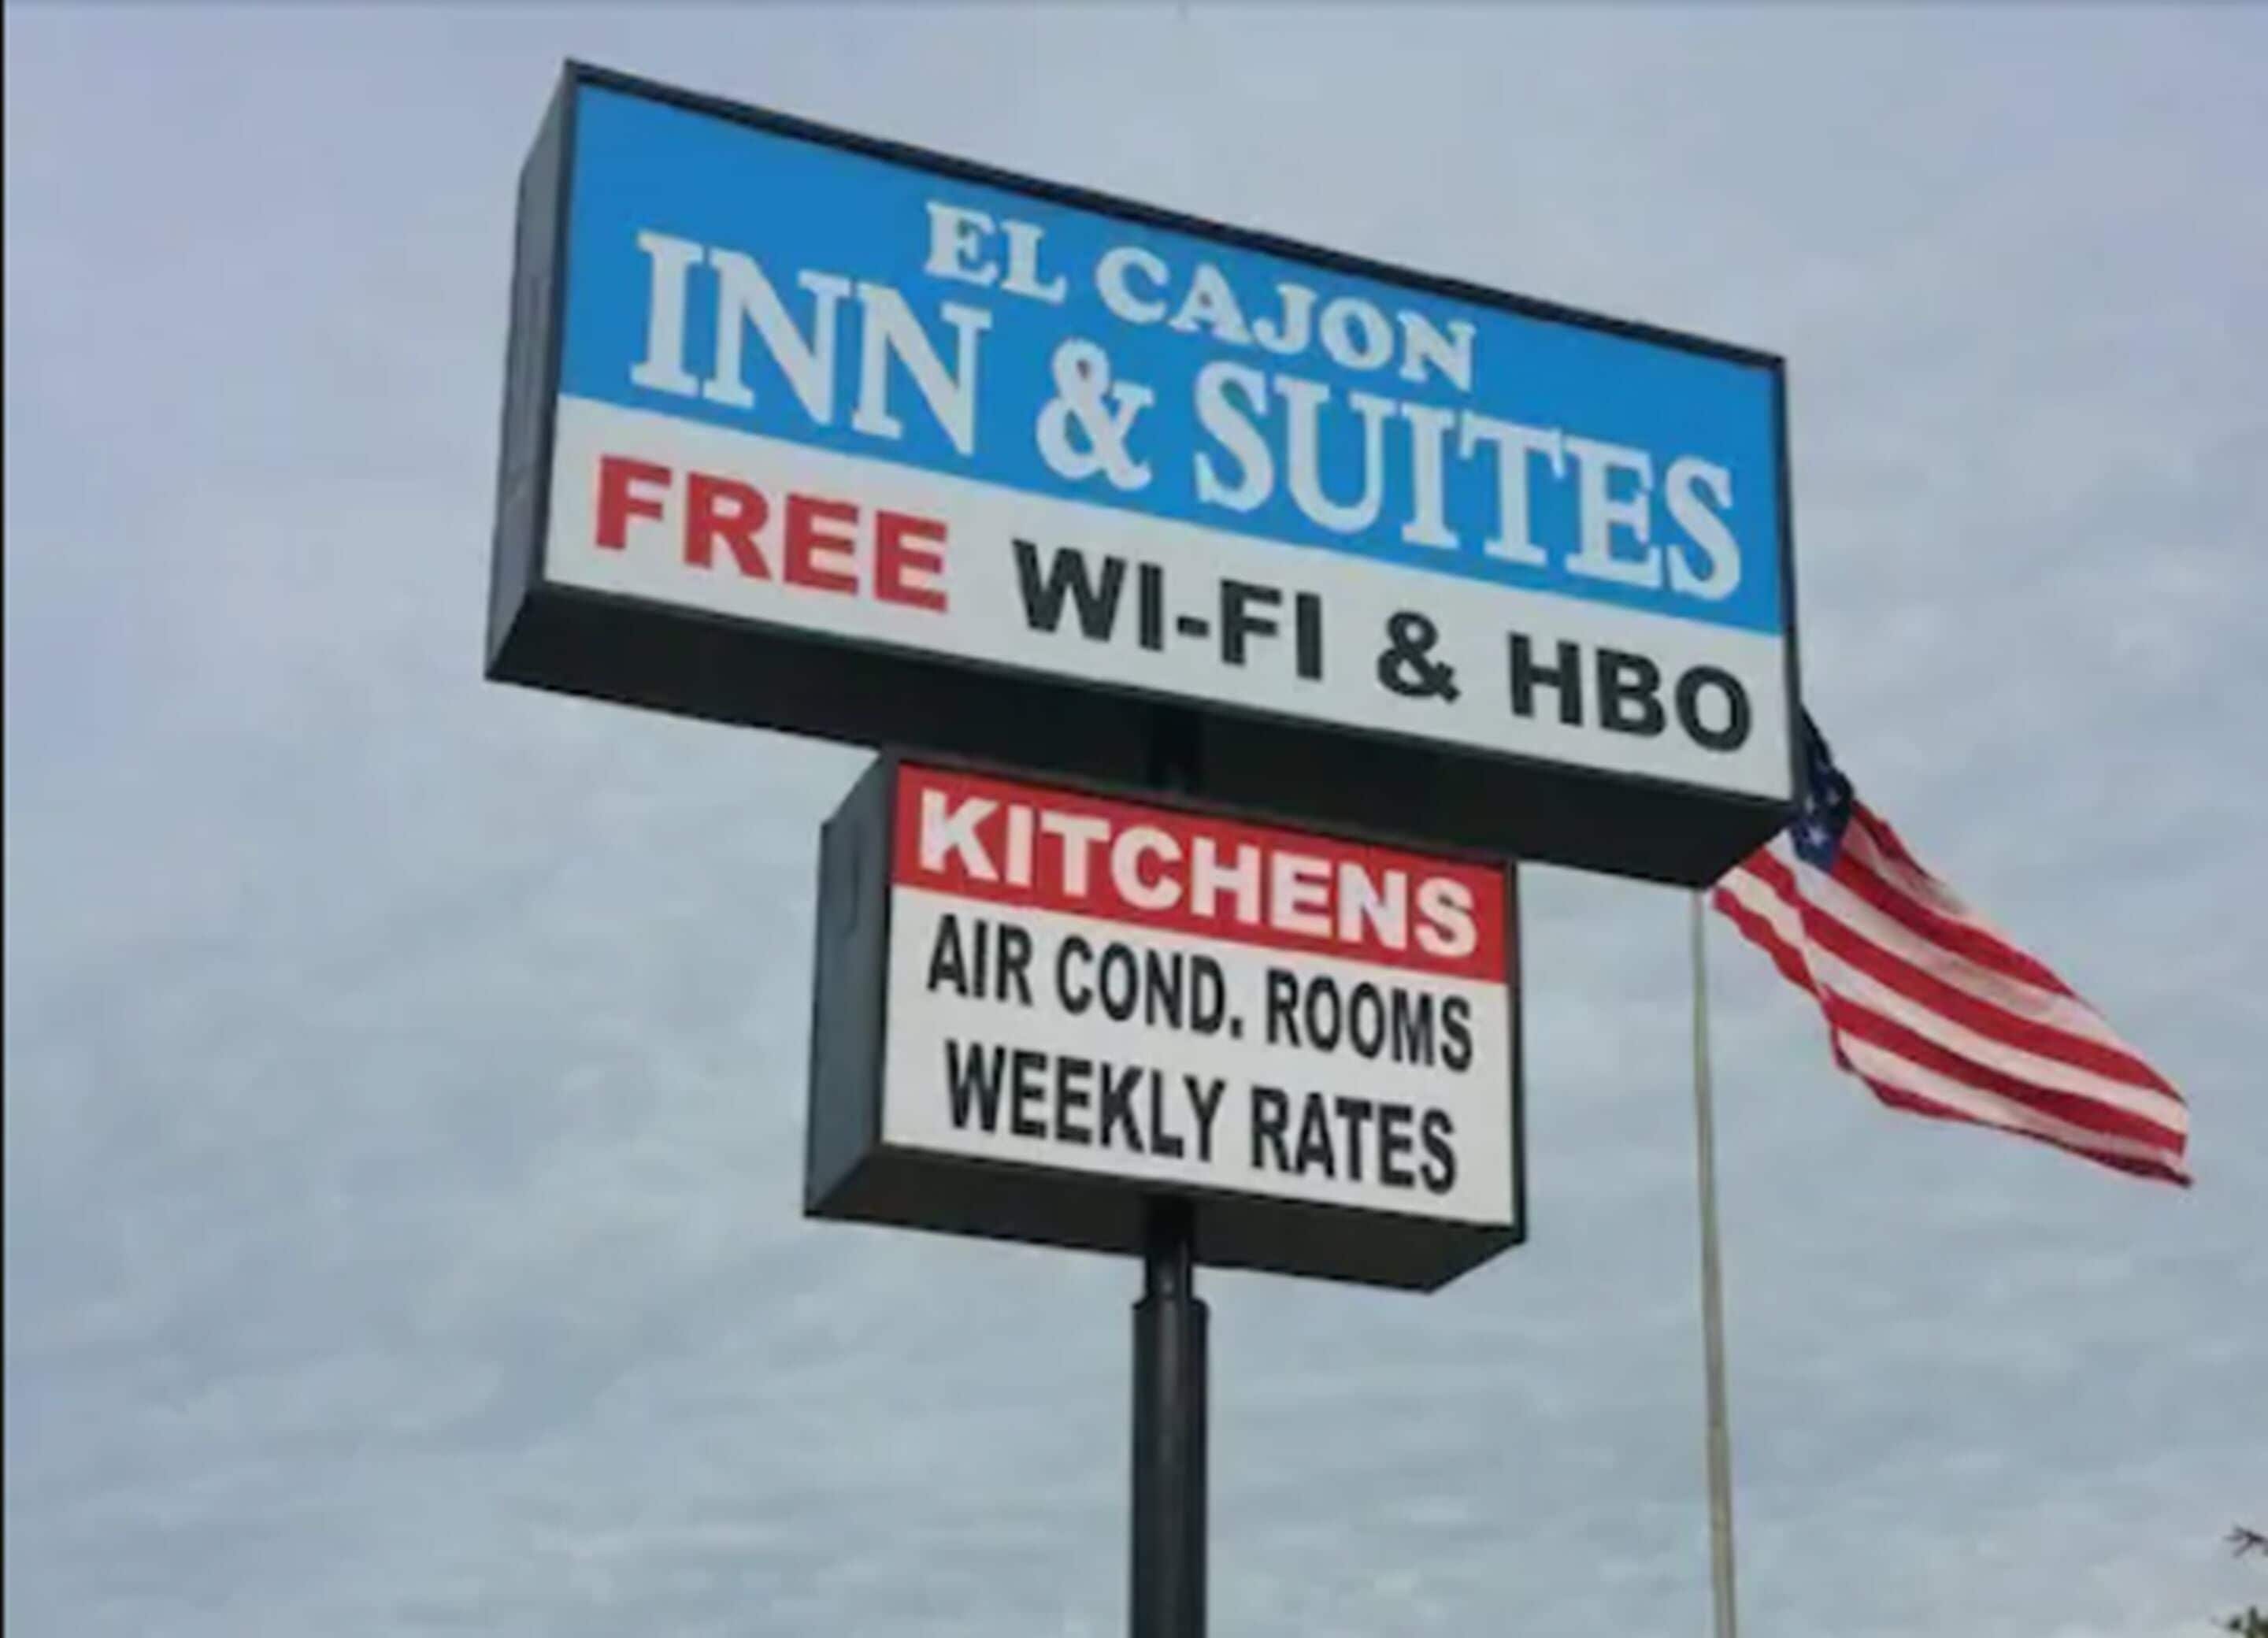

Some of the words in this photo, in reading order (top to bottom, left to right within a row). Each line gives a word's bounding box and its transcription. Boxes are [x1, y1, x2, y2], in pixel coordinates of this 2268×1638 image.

[924, 200, 1066, 303] EL
[1095, 246, 1475, 391] CAJON
[632, 229, 992, 458] INN
[1036, 338, 1153, 490] &
[1194, 361, 1741, 600] SUITES
[595, 454, 949, 614] FREE
[1011, 539, 1323, 680] WI-FI
[1377, 611, 1462, 703] &
[1509, 632, 1751, 752] HBO
[918, 791, 1477, 957] KITCHENS
[928, 913, 1032, 1006] AIR
[1056, 934, 1243, 1039] COND.
[1266, 968, 1473, 1072] ROOMS
[945, 1038, 1225, 1162] WEEKLY
[1250, 1085, 1455, 1195] RATES
